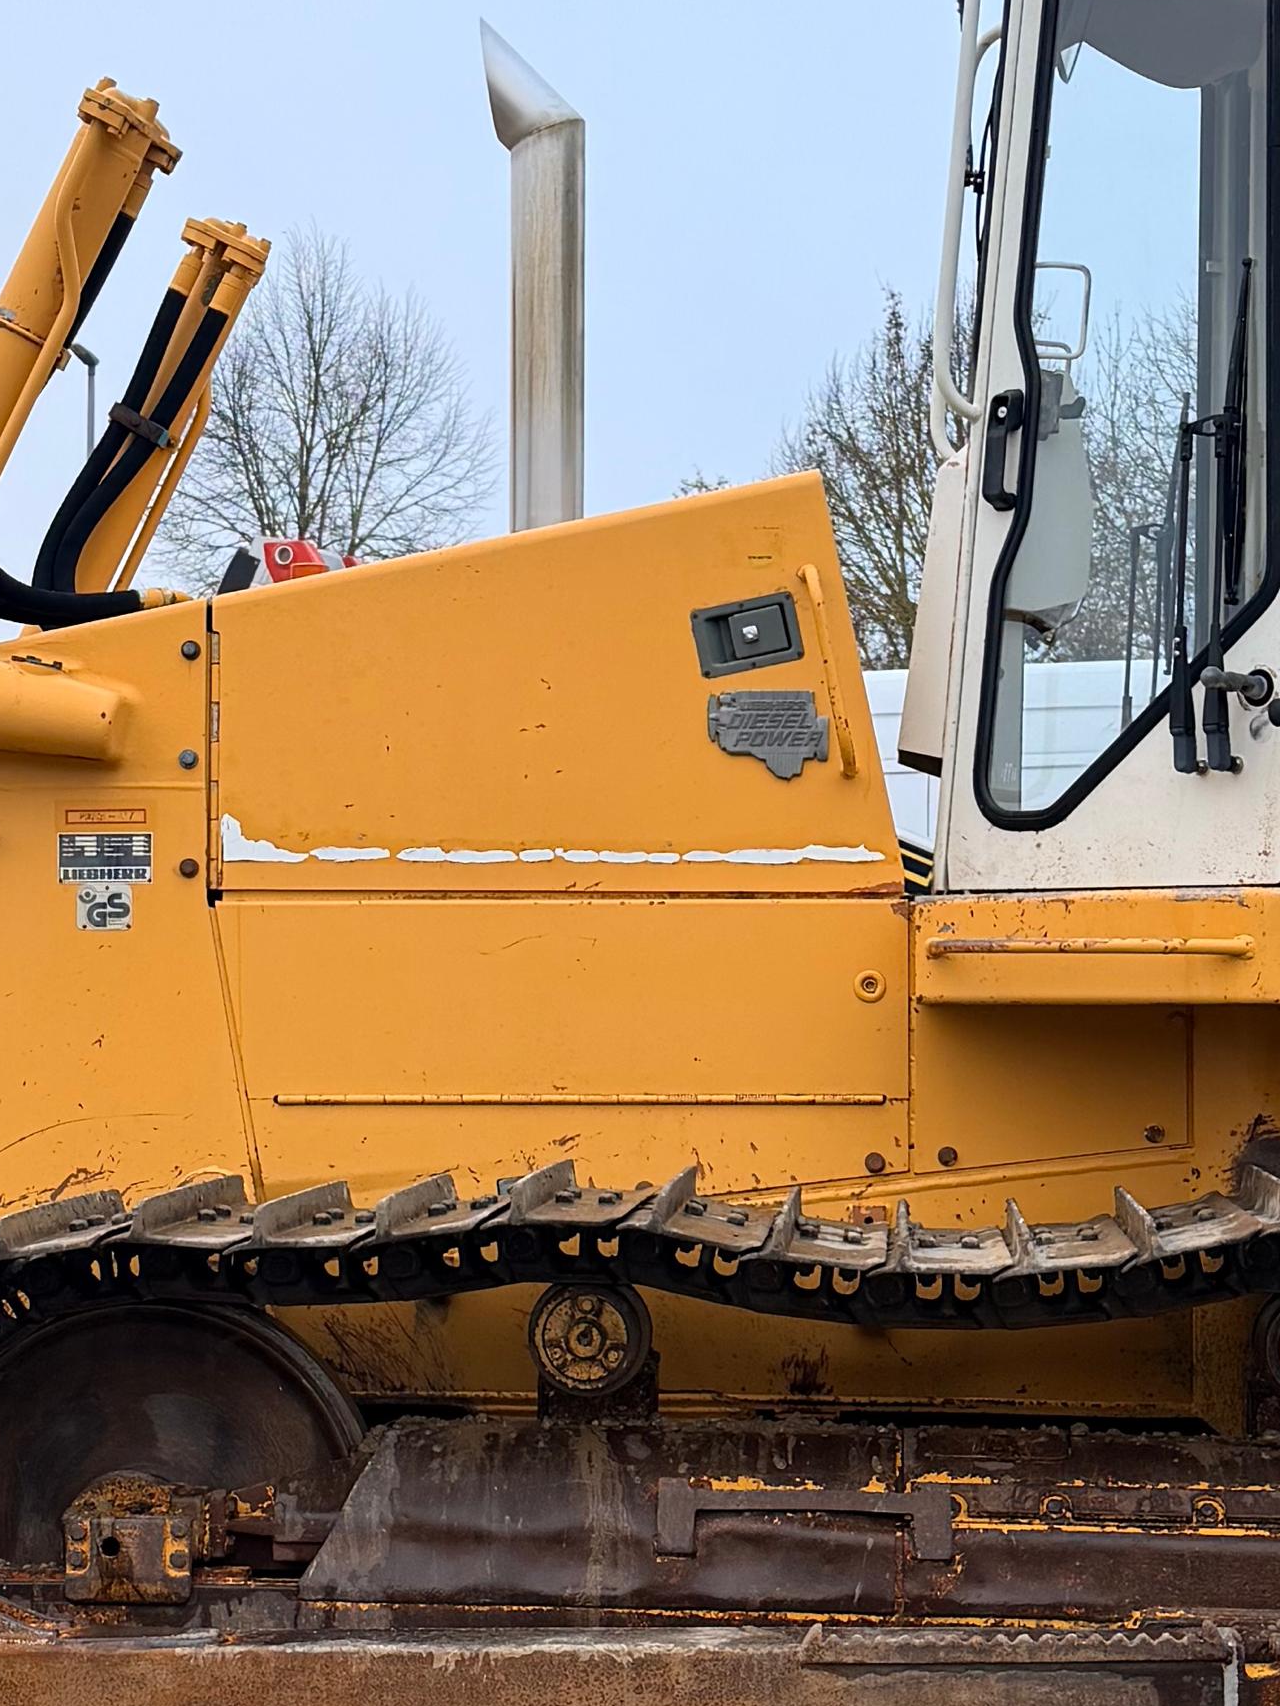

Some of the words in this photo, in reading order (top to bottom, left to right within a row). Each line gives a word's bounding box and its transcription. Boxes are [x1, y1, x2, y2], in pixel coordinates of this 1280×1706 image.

[726, 712, 813, 729] DIESEL
[733, 731, 823, 747] POWER
[62, 868, 148, 881] LIEBHERR
[86, 893, 130, 928] GS
